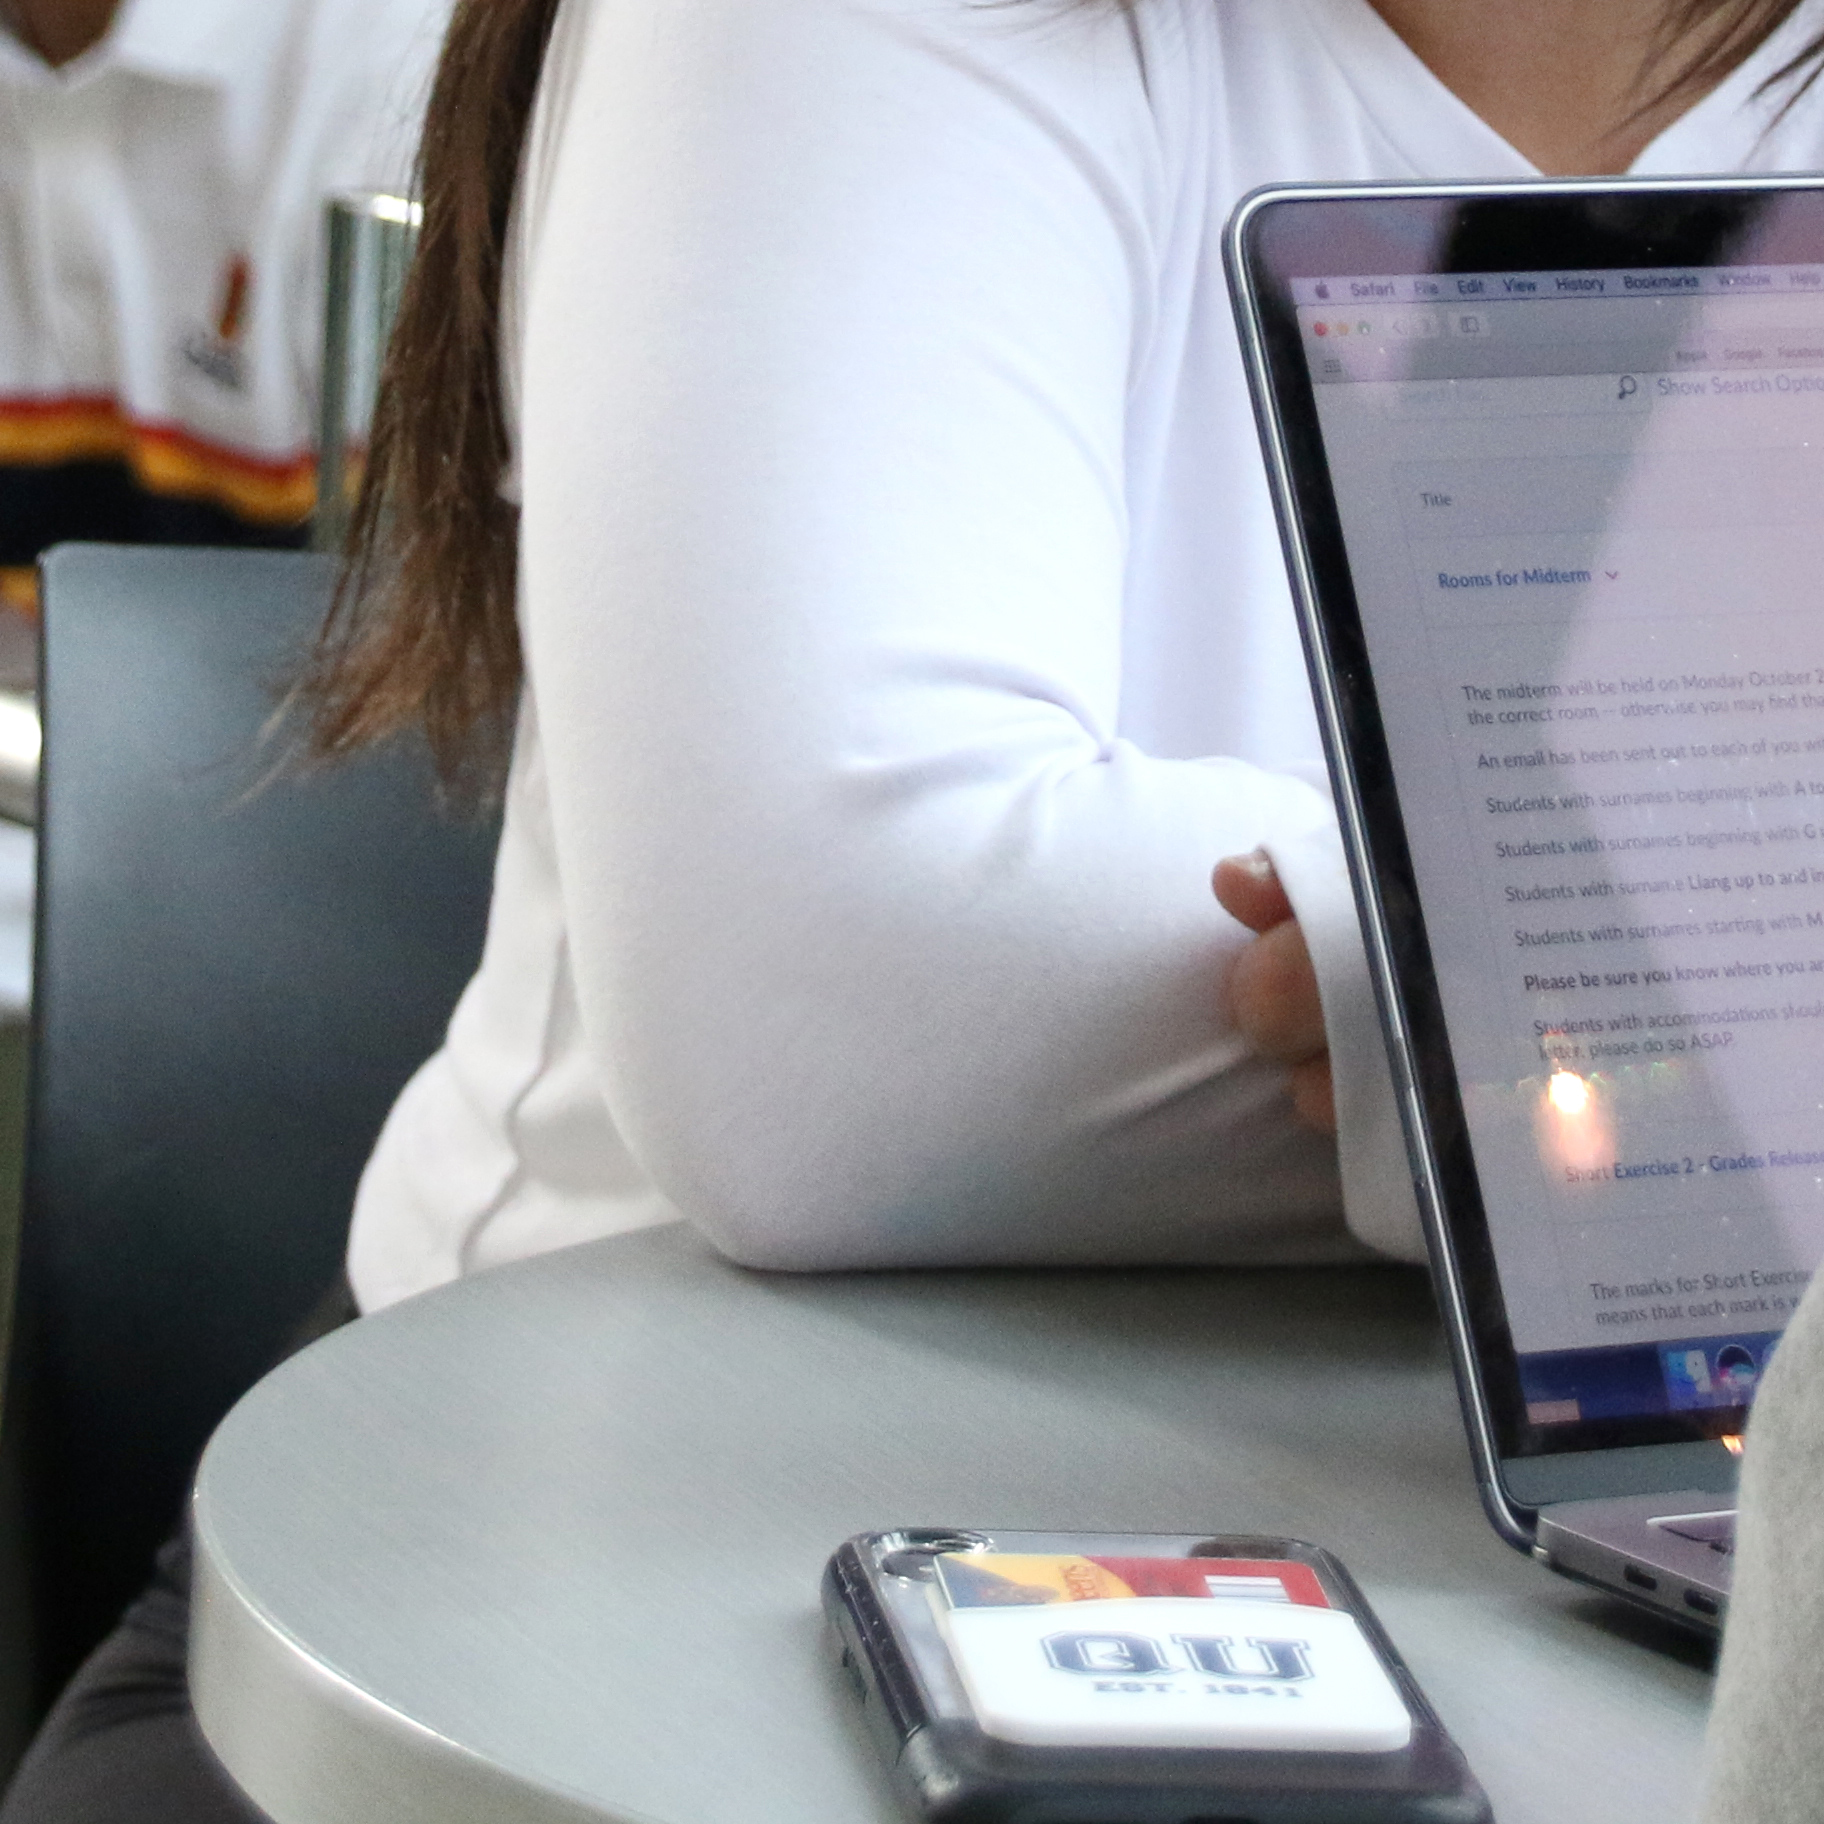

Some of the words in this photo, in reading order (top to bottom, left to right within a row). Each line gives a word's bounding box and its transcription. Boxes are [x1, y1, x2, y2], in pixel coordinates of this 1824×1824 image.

[1350, 280, 1395, 296] Safari
[1457, 279, 1485, 294] Edit
[1502, 278, 1537, 293] View
[1555, 276, 1605, 294] History
[1623, 274, 1700, 290] Bookmarks
[1718, 272, 1770, 287] Window
[1657, 377, 1706, 396] Show
[1712, 376, 1771, 394] Search
[1420, 491, 1453, 508] Title
[1437, 570, 1494, 589] Rooms
[1495, 569, 1519, 587] for
[1522, 567, 1592, 586] Midterm
[1461, 684, 1493, 701] The
[1496, 681, 1562, 700] midterm
[1565, 679, 1595, 696] will
[1595, 678, 1617, 695] be
[1620, 676, 1655, 694] held
[1657, 679, 1680, 692] on
[1680, 673, 1745, 692] Monday
[1747, 669, 1812, 687] October
[1467, 708, 1494, 725] the
[1497, 704, 1555, 723] correct
[1557, 706, 1599, 720] room
[1619, 698, 1697, 717] otherwise
[1699, 700, 1730, 717] you
[1732, 698, 1765, 715] may
[1767, 693, 1799, 710] find
[1476, 752, 1500, 769] An
[1502, 749, 1547, 768] email
[1548, 749, 1576, 766] has
[1579, 747, 1619, 764] been
[1621, 744, 1656, 762] sent
[1660, 742, 1688, 760] out
[1689, 742, 1708, 758] to
[1710, 739, 1748, 757] each
[1751, 738, 1769, 755] of
[1770, 741, 1800, 758] you
[1486, 793, 1557, 813] Students
[1559, 791, 1595, 809] with
[1599, 791, 1673, 807] surnames
[1676, 784, 1752, 806] beginning
[1756, 781, 1790, 798] with
[1793, 780, 1806, 796] A
[1495, 838, 1566, 858] Students
[1568, 836, 1605, 854] with
[1609, 835, 1682, 851] surnames
[1686, 828, 1761, 850] beginning
[1765, 824, 1800, 842] with
[1802, 824, 1817, 840] G
[1504, 883, 1575, 903] Students
[1577, 880, 1615, 898] with
[1617, 880, 1686, 896] surname
[1688, 875, 1732, 894] Liang
[1733, 876, 1755, 892] up
[1757, 871, 1776, 887] to
[1778, 869, 1808, 886] and
[1514, 927, 1585, 947] Students
[1587, 924, 1624, 943] with
[1627, 924, 1702, 940] surnames
[1705, 917, 1766, 936] starting
[1769, 914, 1803, 931] with
[1806, 913, 1824, 929] M
[1522, 973, 1578, 991] Please
[1580, 970, 1601, 987] be
[1604, 971, 1639, 986] sure
[1641, 969, 1673, 987] you
[1674, 964, 1720, 981] know
[1722, 961, 1772, 978] where
[1773, 961, 1806, 979] you
[1532, 1015, 1604, 1036] Students
[1606, 1012, 1644, 1031] with
[1646, 1005, 1778, 1028] accommodations
[1588, 1040, 1639, 1061] please
[1642, 1036, 1665, 1053] do
[1668, 1038, 1687, 1051] so
[1564, 1163, 1611, 1182] Short
[1613, 1159, 1681, 1178] Exercise
[1682, 1157, 1695, 1173] 2
[1707, 1154, 1765, 1172] Grades
[1589, 1283, 1621, 1300] The
[1623, 1278, 1674, 1297] marks
[1675, 1277, 1700, 1293] for
[1701, 1272, 1747, 1291] Short
[1595, 1308, 1649, 1324] means
[1650, 1302, 1684, 1320] that
[1686, 1299, 1726, 1317] each
[1728, 1295, 1770, 1314] mark
[1771, 1295, 1785, 1311] is
[1039, 1630, 1316, 1682] QU
[1092, 1680, 1187, 1694] EST.
[1205, 1683, 1304, 1698] 1841
